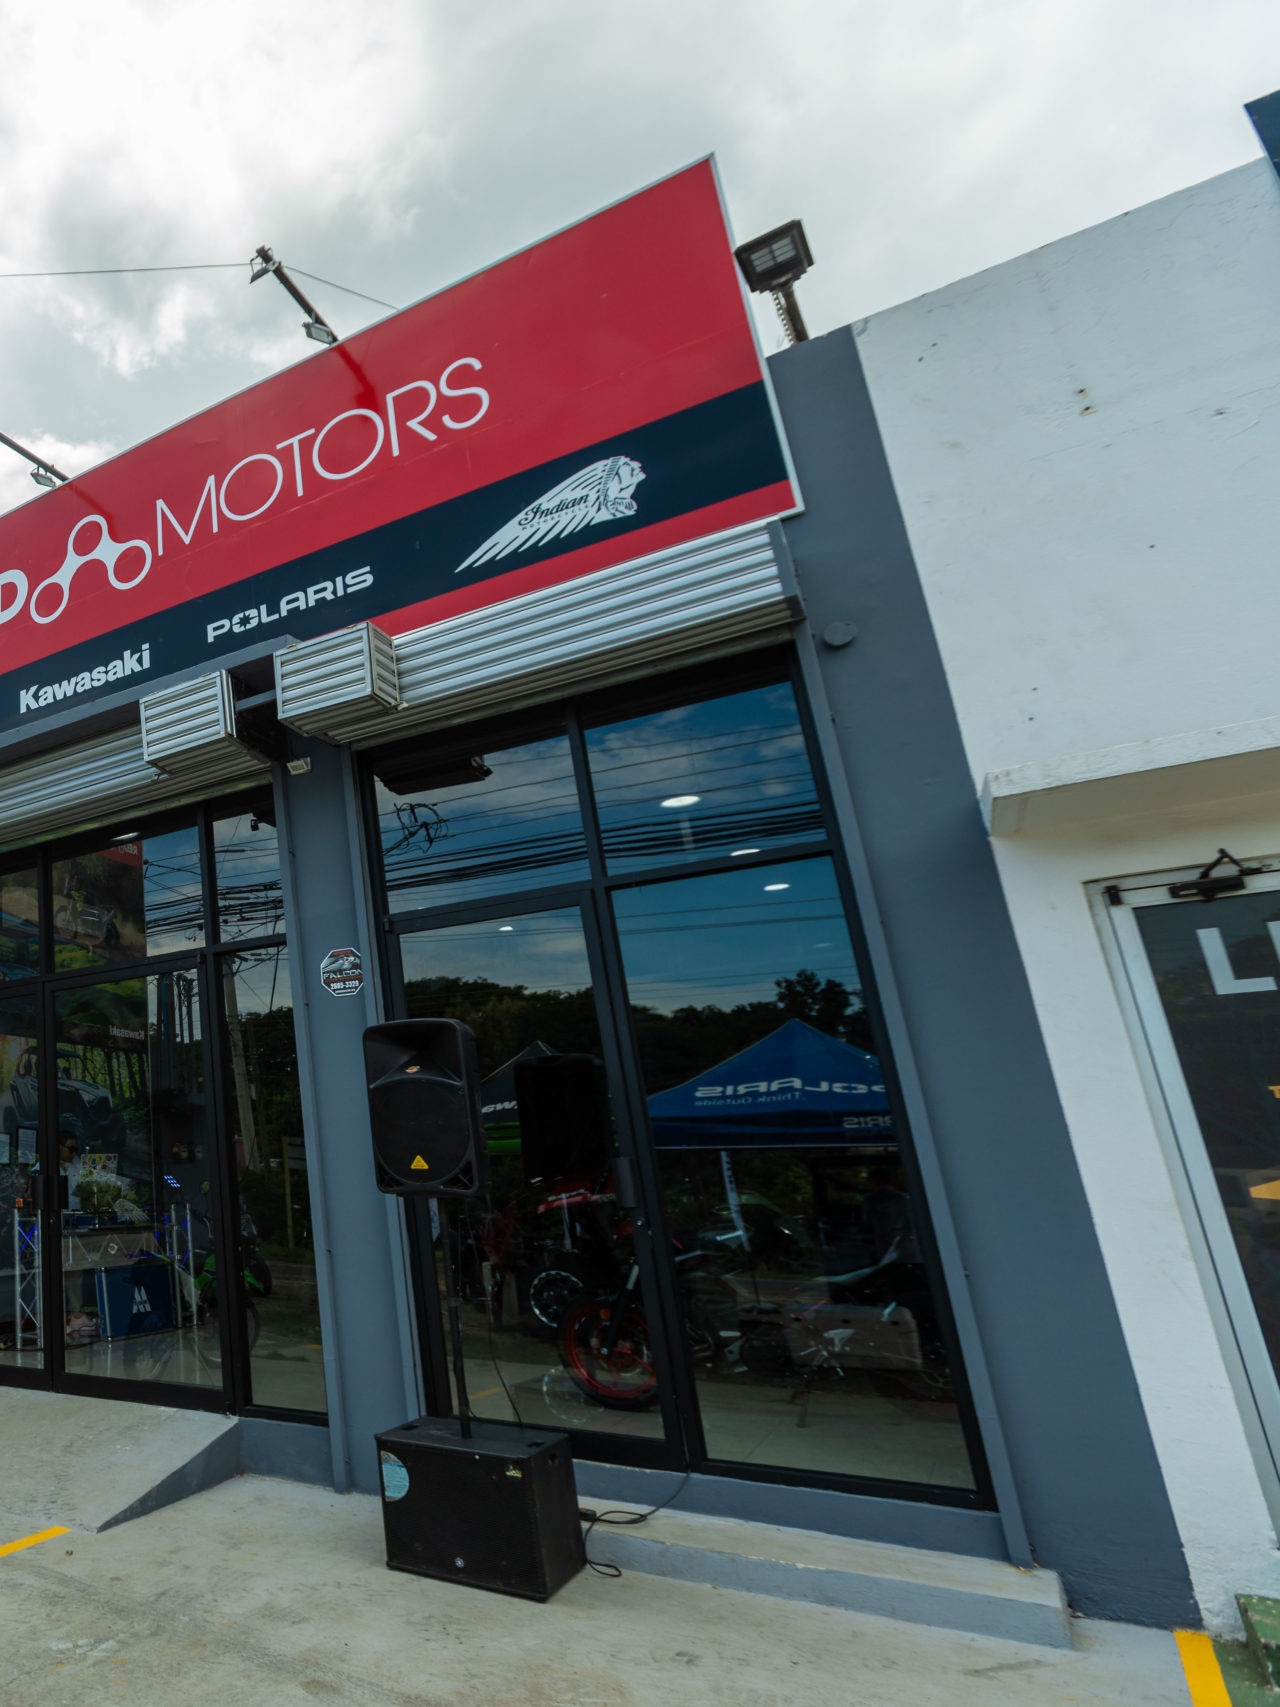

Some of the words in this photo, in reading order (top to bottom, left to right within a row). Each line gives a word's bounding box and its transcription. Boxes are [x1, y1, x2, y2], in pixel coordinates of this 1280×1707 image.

[156, 356, 490, 556] MOTORS
[517, 493, 590, 526] Indian
[206, 565, 374, 643] POLARIS
[19, 642, 151, 714] Kawasaki
[323, 969, 363, 980] FALCON
